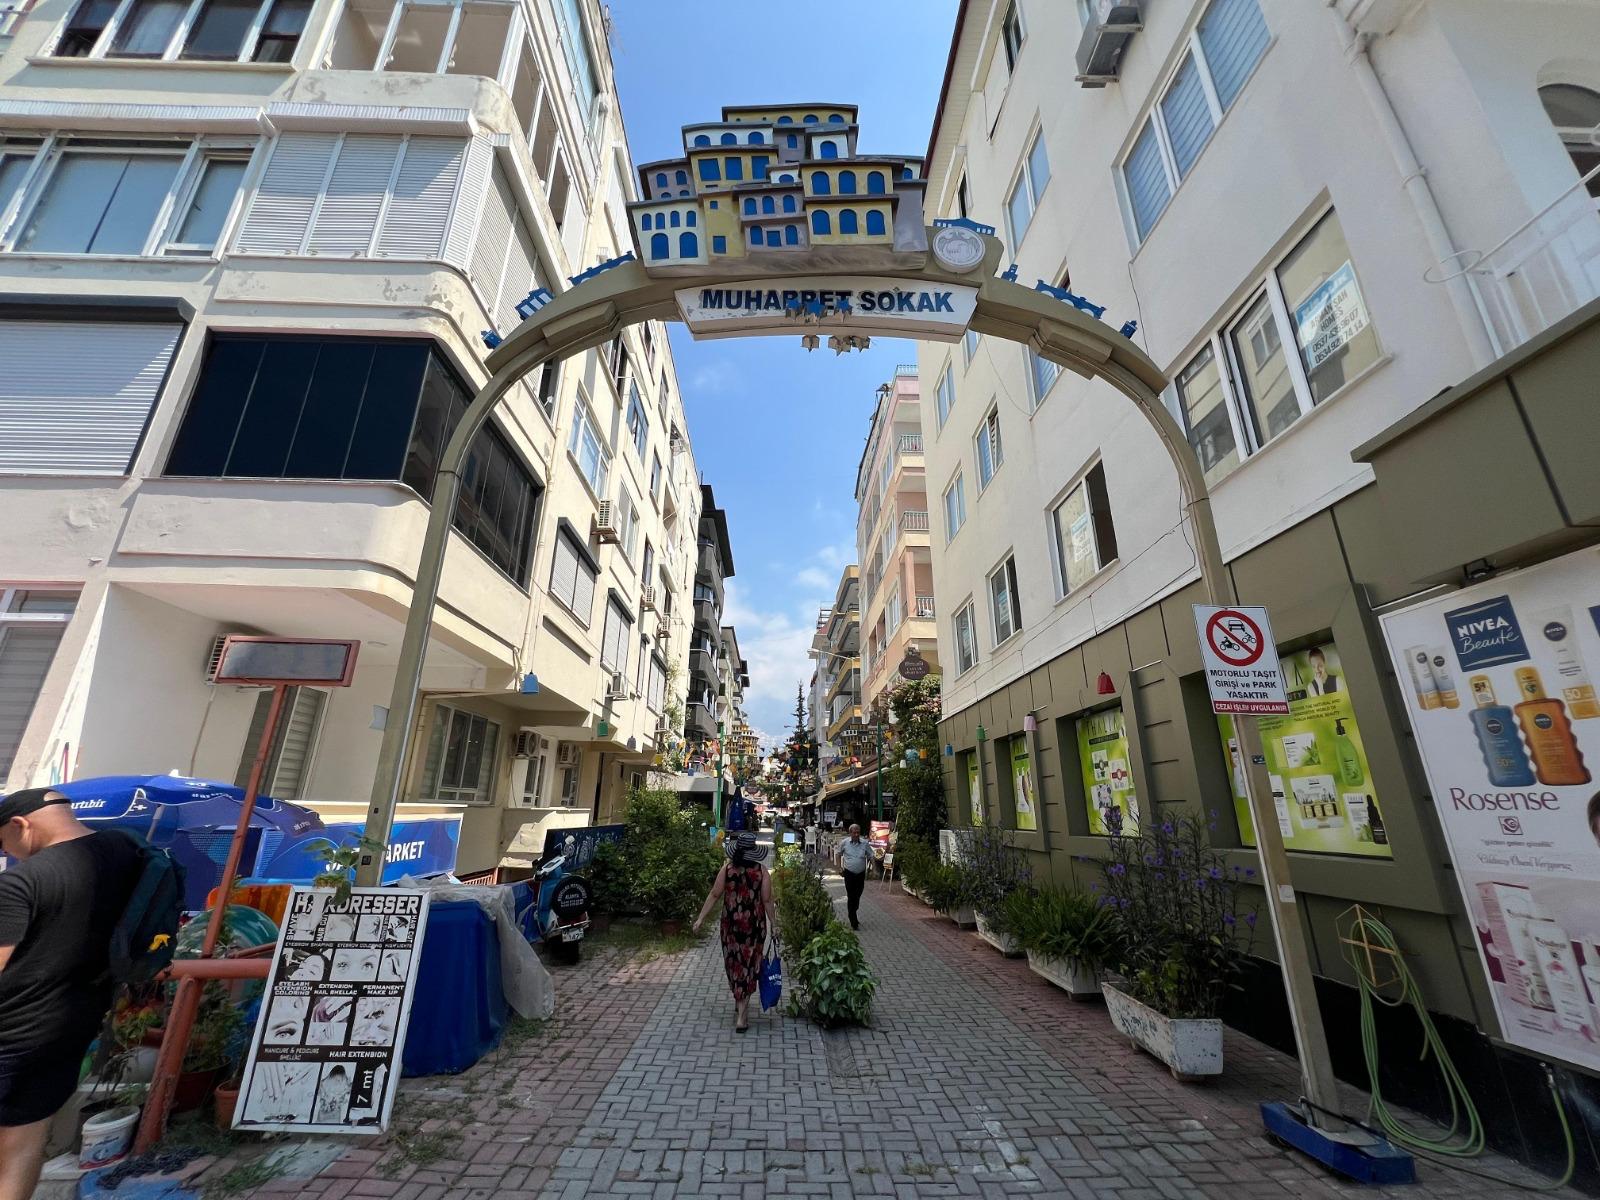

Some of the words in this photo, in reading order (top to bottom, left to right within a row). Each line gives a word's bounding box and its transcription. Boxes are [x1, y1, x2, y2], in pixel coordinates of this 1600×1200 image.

[859, 289, 954, 313] SOKAK
[1456, 615, 1510, 638] NIVEA
[1458, 627, 1520, 656] Beauté
[1209, 669, 1250, 678] MOTORLU
[1253, 670, 1277, 680] TAŞIT
[1252, 681, 1277, 689] PARK
[1226, 690, 1269, 699] YASAKTIR
[1449, 787, 1561, 812] Rosense
[385, 840, 425, 864] ARKET
[286, 914, 298, 941] SHAVE
[362, 1069, 374, 1090] mt
[356, 1094, 369, 1105] 7
